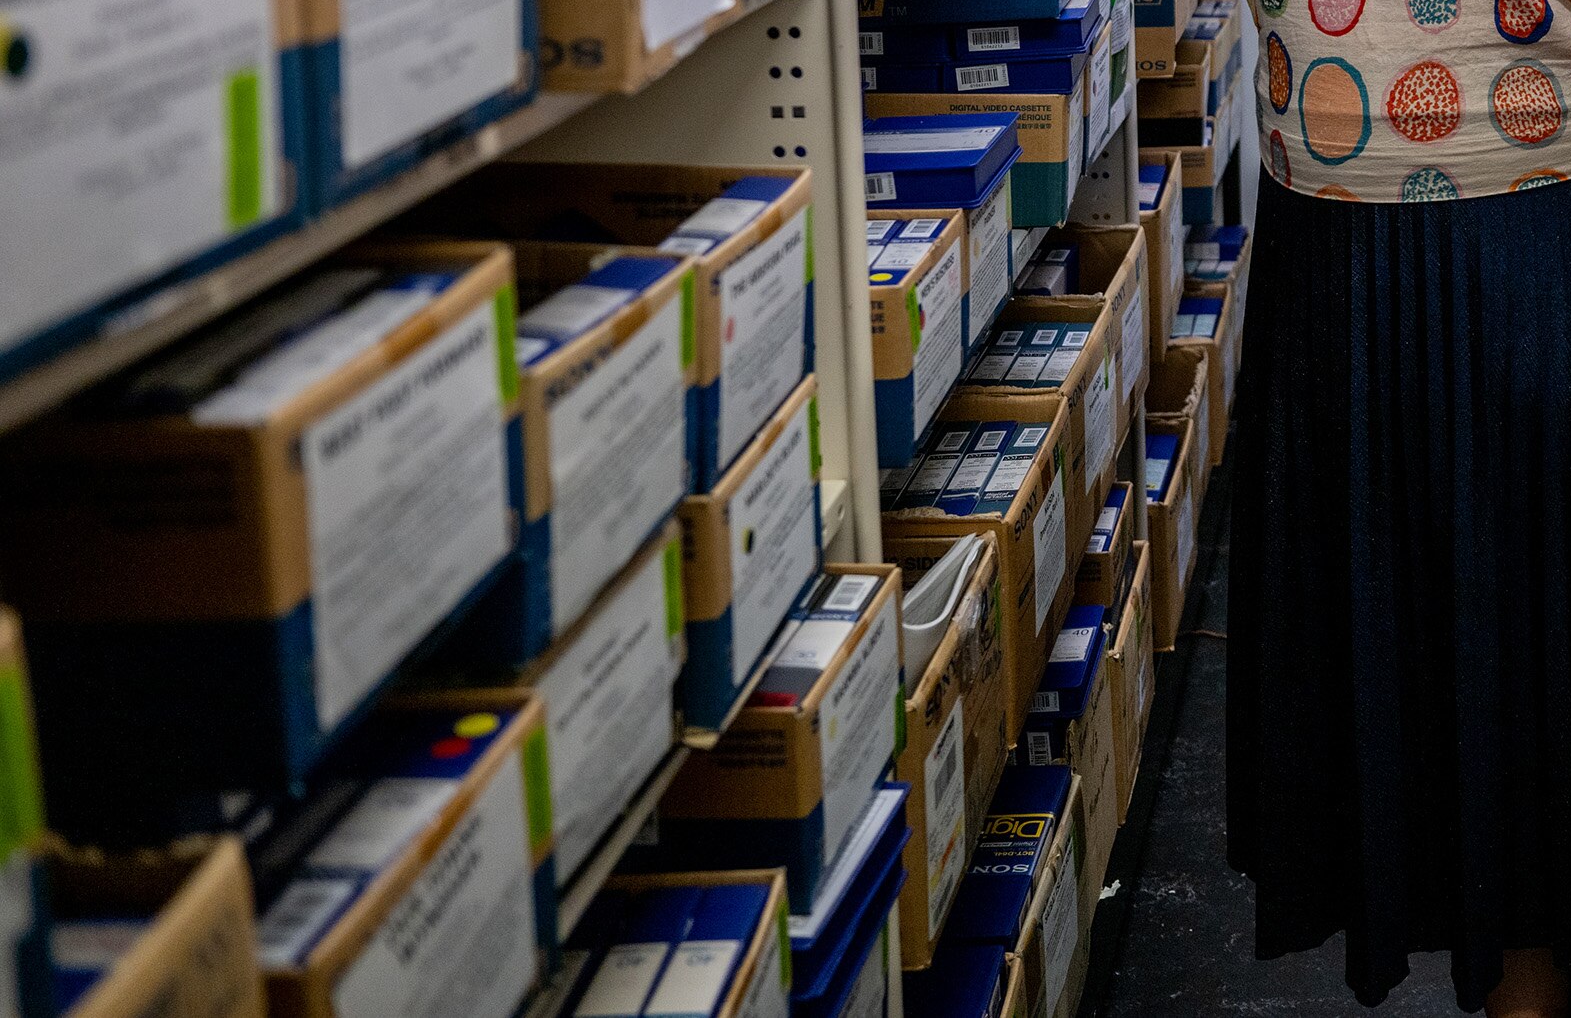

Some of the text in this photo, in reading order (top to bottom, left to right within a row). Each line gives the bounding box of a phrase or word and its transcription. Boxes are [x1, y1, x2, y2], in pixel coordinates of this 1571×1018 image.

[889, 7, 907, 16] TM
[543, 39, 604, 70] SO
[950, 104, 1052, 112] DIGITAL VIDEO CASSETTE
[1017, 113, 1052, 121] ÉRIQUE
[1014, 490, 1038, 543] SONY
[1072, 628, 1089, 636] 40
[983, 817, 1046, 839] Digi
[971, 863, 1030, 874] SON
